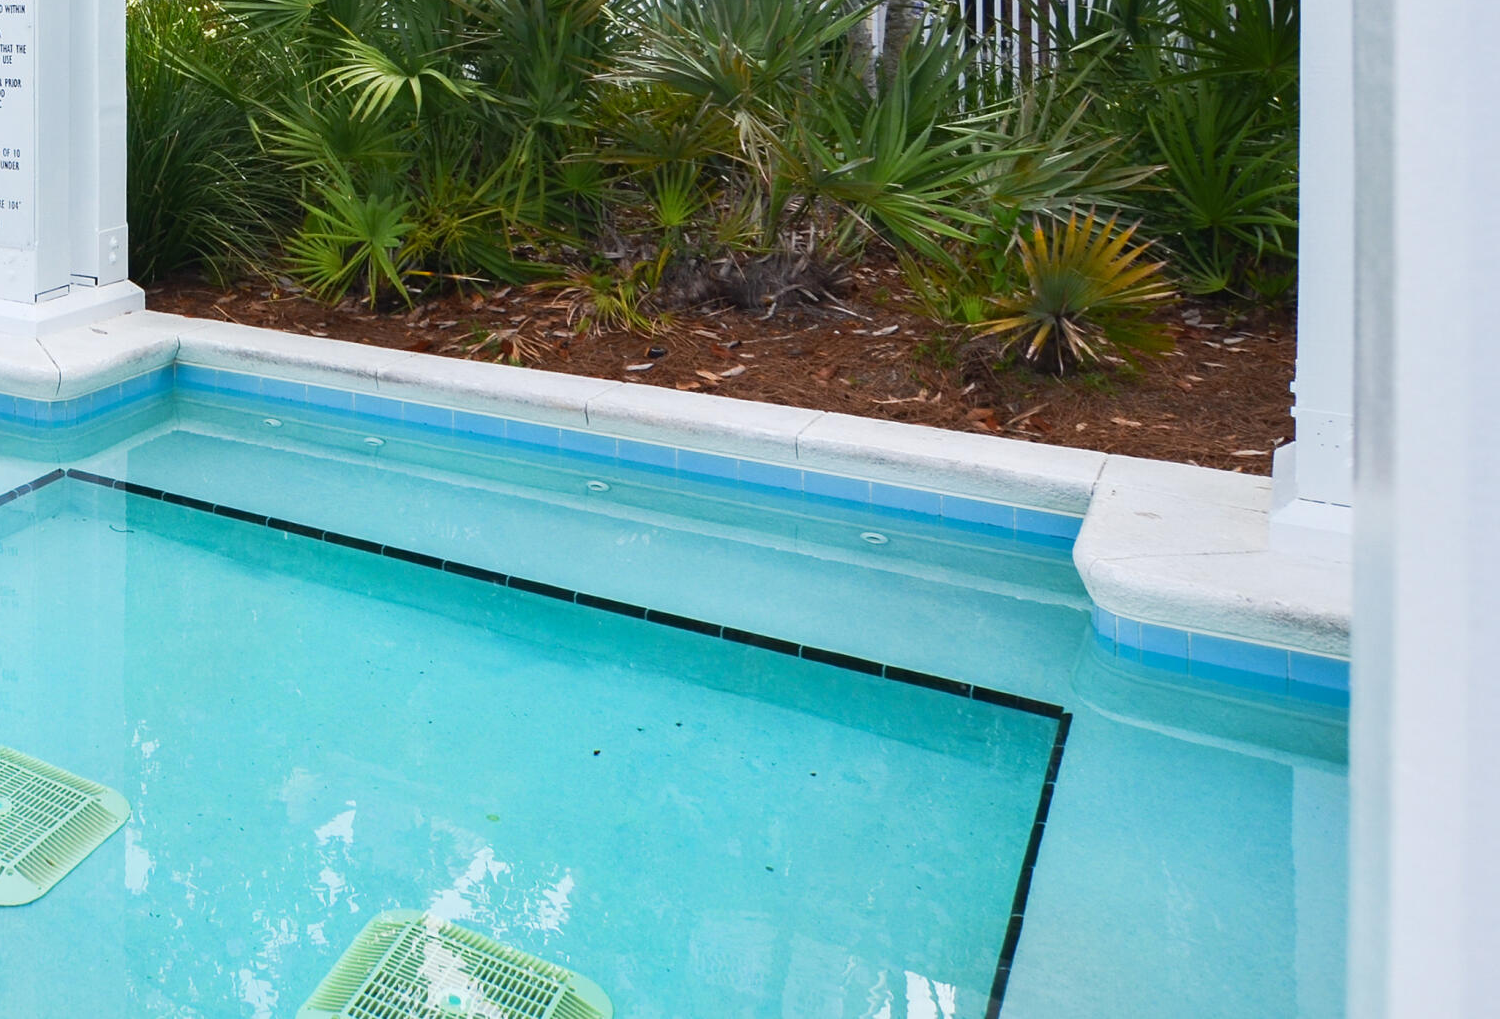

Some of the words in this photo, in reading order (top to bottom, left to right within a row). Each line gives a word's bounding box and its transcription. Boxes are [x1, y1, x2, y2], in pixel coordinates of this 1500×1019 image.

[5, 4, 26, 14] WITHIN
[0, 44, 13, 53] THAT
[16, 44, 26, 54] THE
[2, 55, 12, 64] USE
[5, 78, 22, 88] PRIOR
[2, 148, 10, 157] OF
[13, 149, 20, 158] 10
[0, 160, 20, 171] UNDER
